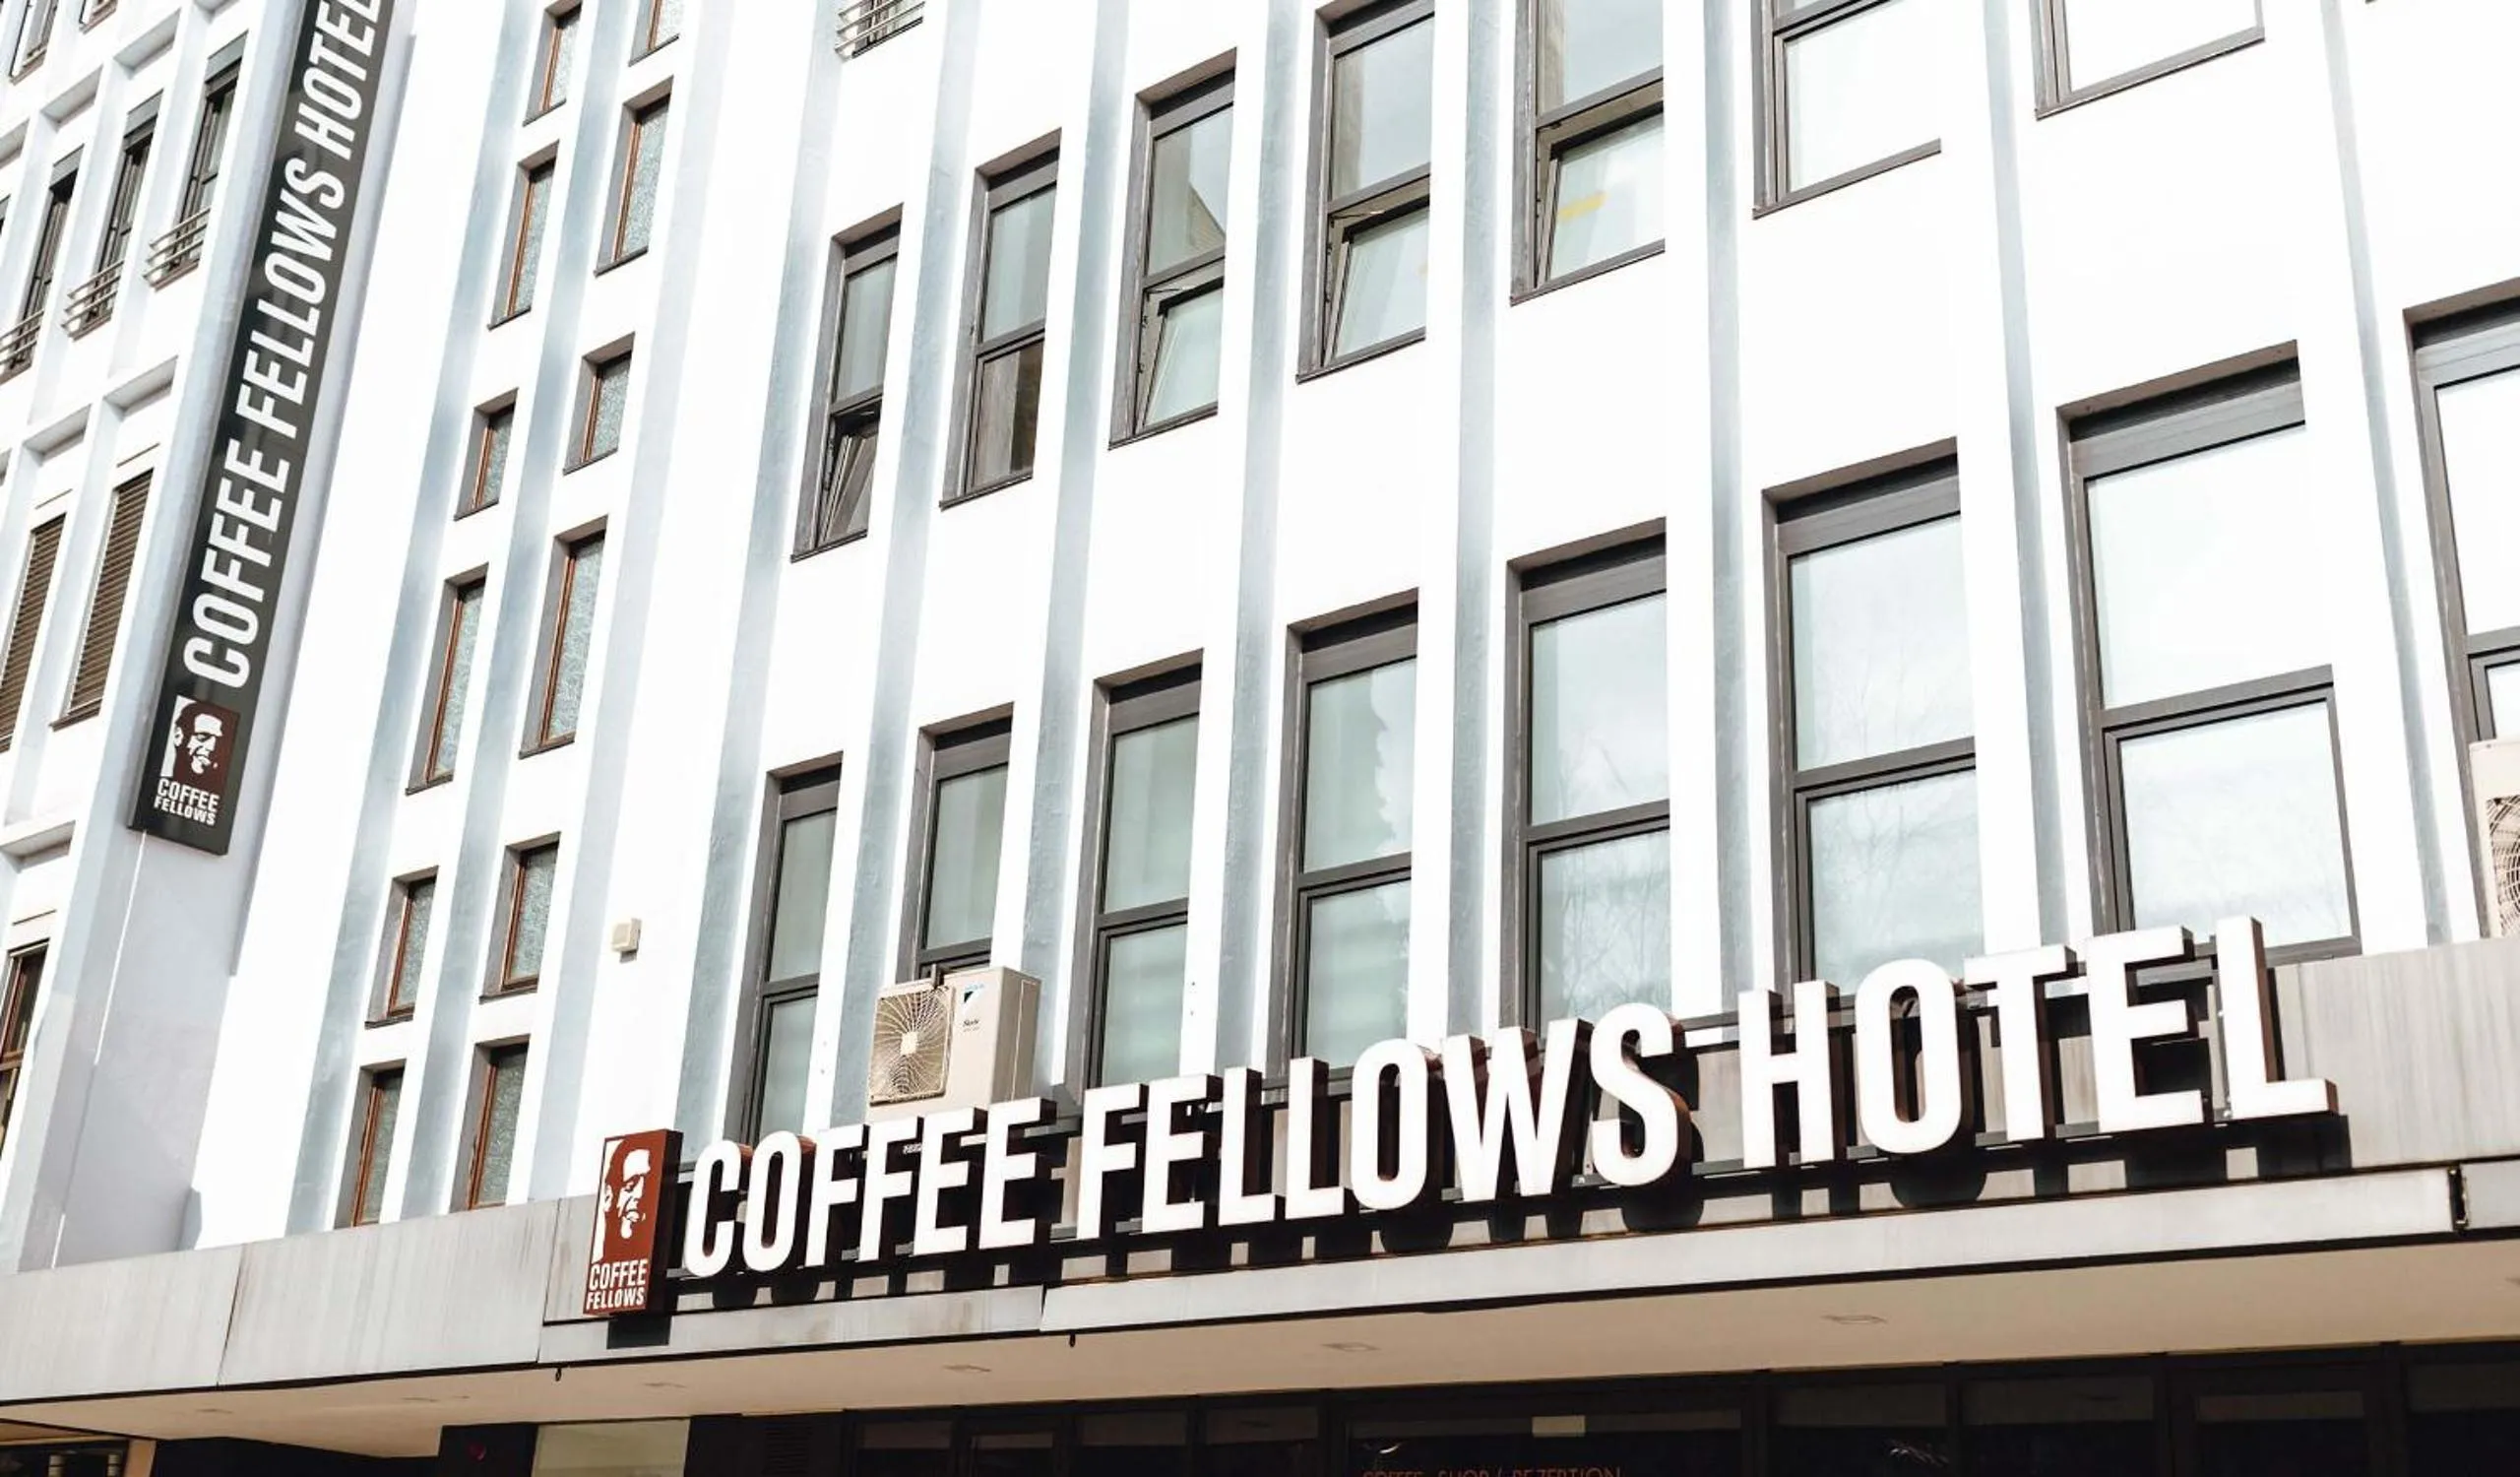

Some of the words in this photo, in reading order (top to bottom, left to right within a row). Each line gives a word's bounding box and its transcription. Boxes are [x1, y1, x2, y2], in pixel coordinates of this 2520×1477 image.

[293, 0, 381, 161] HOTEL
[235, 158, 346, 439] FELLOWS
[183, 438, 290, 689] COFFEE
[154, 795, 216, 826] FELLOWS
[158, 777, 220, 813] COFFEE
[682, 1097, 1041, 1278] COFFEE
[1076, 1002, 1678, 1240] FELLOWS
[1737, 916, 2330, 1169] HOTEL
[586, 1286, 645, 1311] FELLOWS
[589, 1257, 649, 1291] COFFEE
